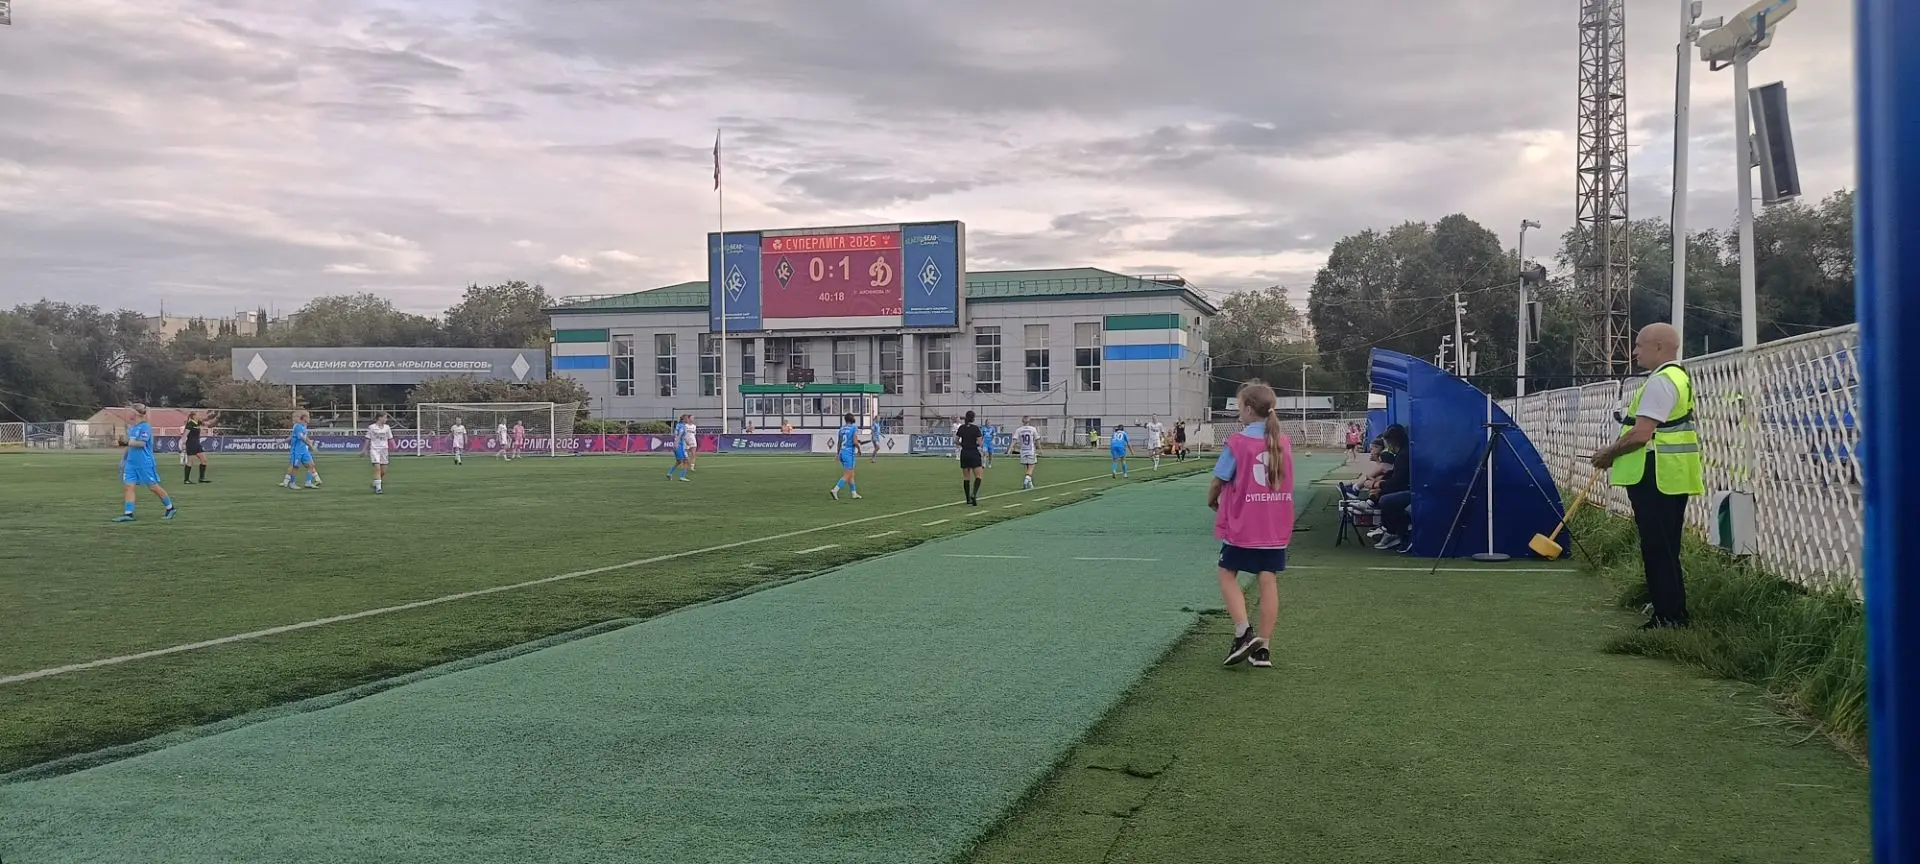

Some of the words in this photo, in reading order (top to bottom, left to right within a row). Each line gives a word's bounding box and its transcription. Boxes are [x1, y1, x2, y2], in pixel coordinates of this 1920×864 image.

[786, 238, 845, 250] СУПЕРЛИГА
[850, 235, 877, 248] 2026
[819, 292, 845, 302] 40:18
[291, 360, 347, 369] АКАДЕМИЯ
[348, 360, 396, 369] ФУТБОЛА
[397, 360, 442, 369] «КРЫЛЬЯ
[444, 360, 493, 369] СОВЕТОВ»
[554, 438, 579, 449] 2026
[748, 440, 779, 448] Земский
[780, 440, 797, 448] банк
[1245, 492, 1292, 503] СУПЕРЛИГА
